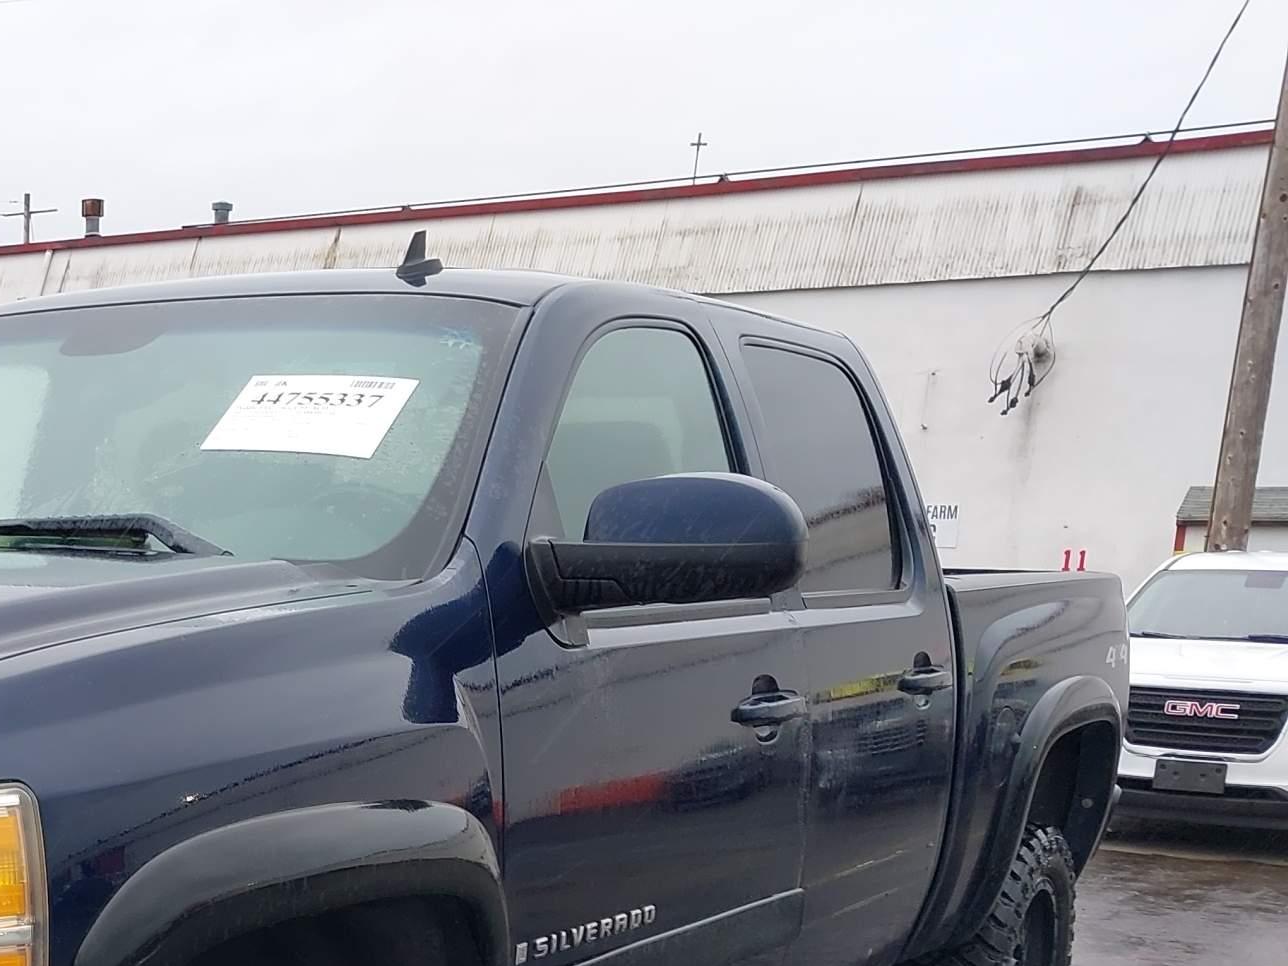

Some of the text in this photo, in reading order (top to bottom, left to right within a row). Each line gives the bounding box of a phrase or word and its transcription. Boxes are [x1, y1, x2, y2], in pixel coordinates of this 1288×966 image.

[250, 392, 385, 408] 44755337
[926, 504, 958, 520] FARM
[1062, 550, 1087, 572] 11
[1105, 643, 1128, 669] 44
[1164, 700, 1241, 720] GMC
[534, 904, 657, 958] SILVERADO
